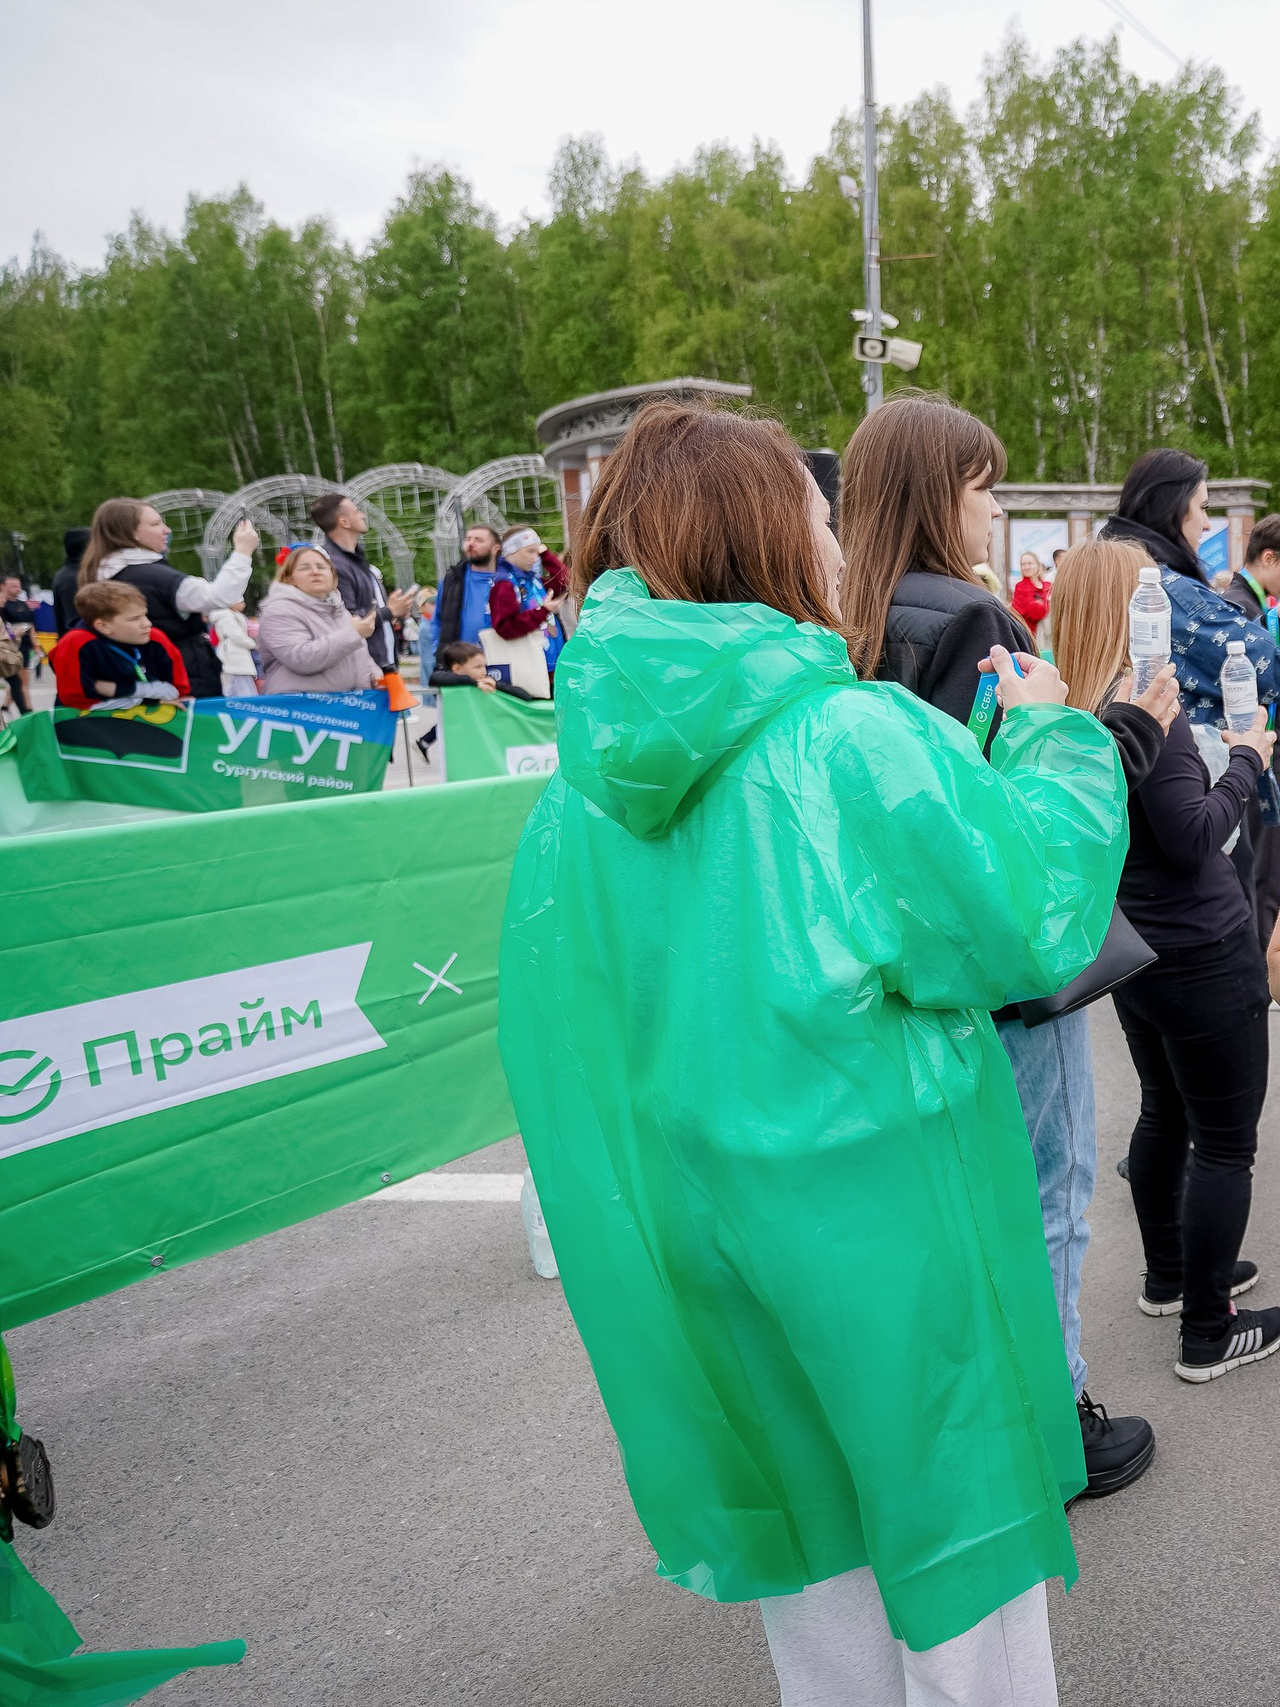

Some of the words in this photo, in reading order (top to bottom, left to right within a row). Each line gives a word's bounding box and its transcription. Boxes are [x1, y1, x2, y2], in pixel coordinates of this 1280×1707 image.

[225, 700, 290, 719] сельское
[981, 684, 994, 710] СБЕР
[292, 710, 361, 731] поселение
[216, 711, 364, 772] УГУТ
[212, 759, 306, 785] Сургутский
[307, 773, 354, 791] район
[82, 997, 323, 1089] Прайм
